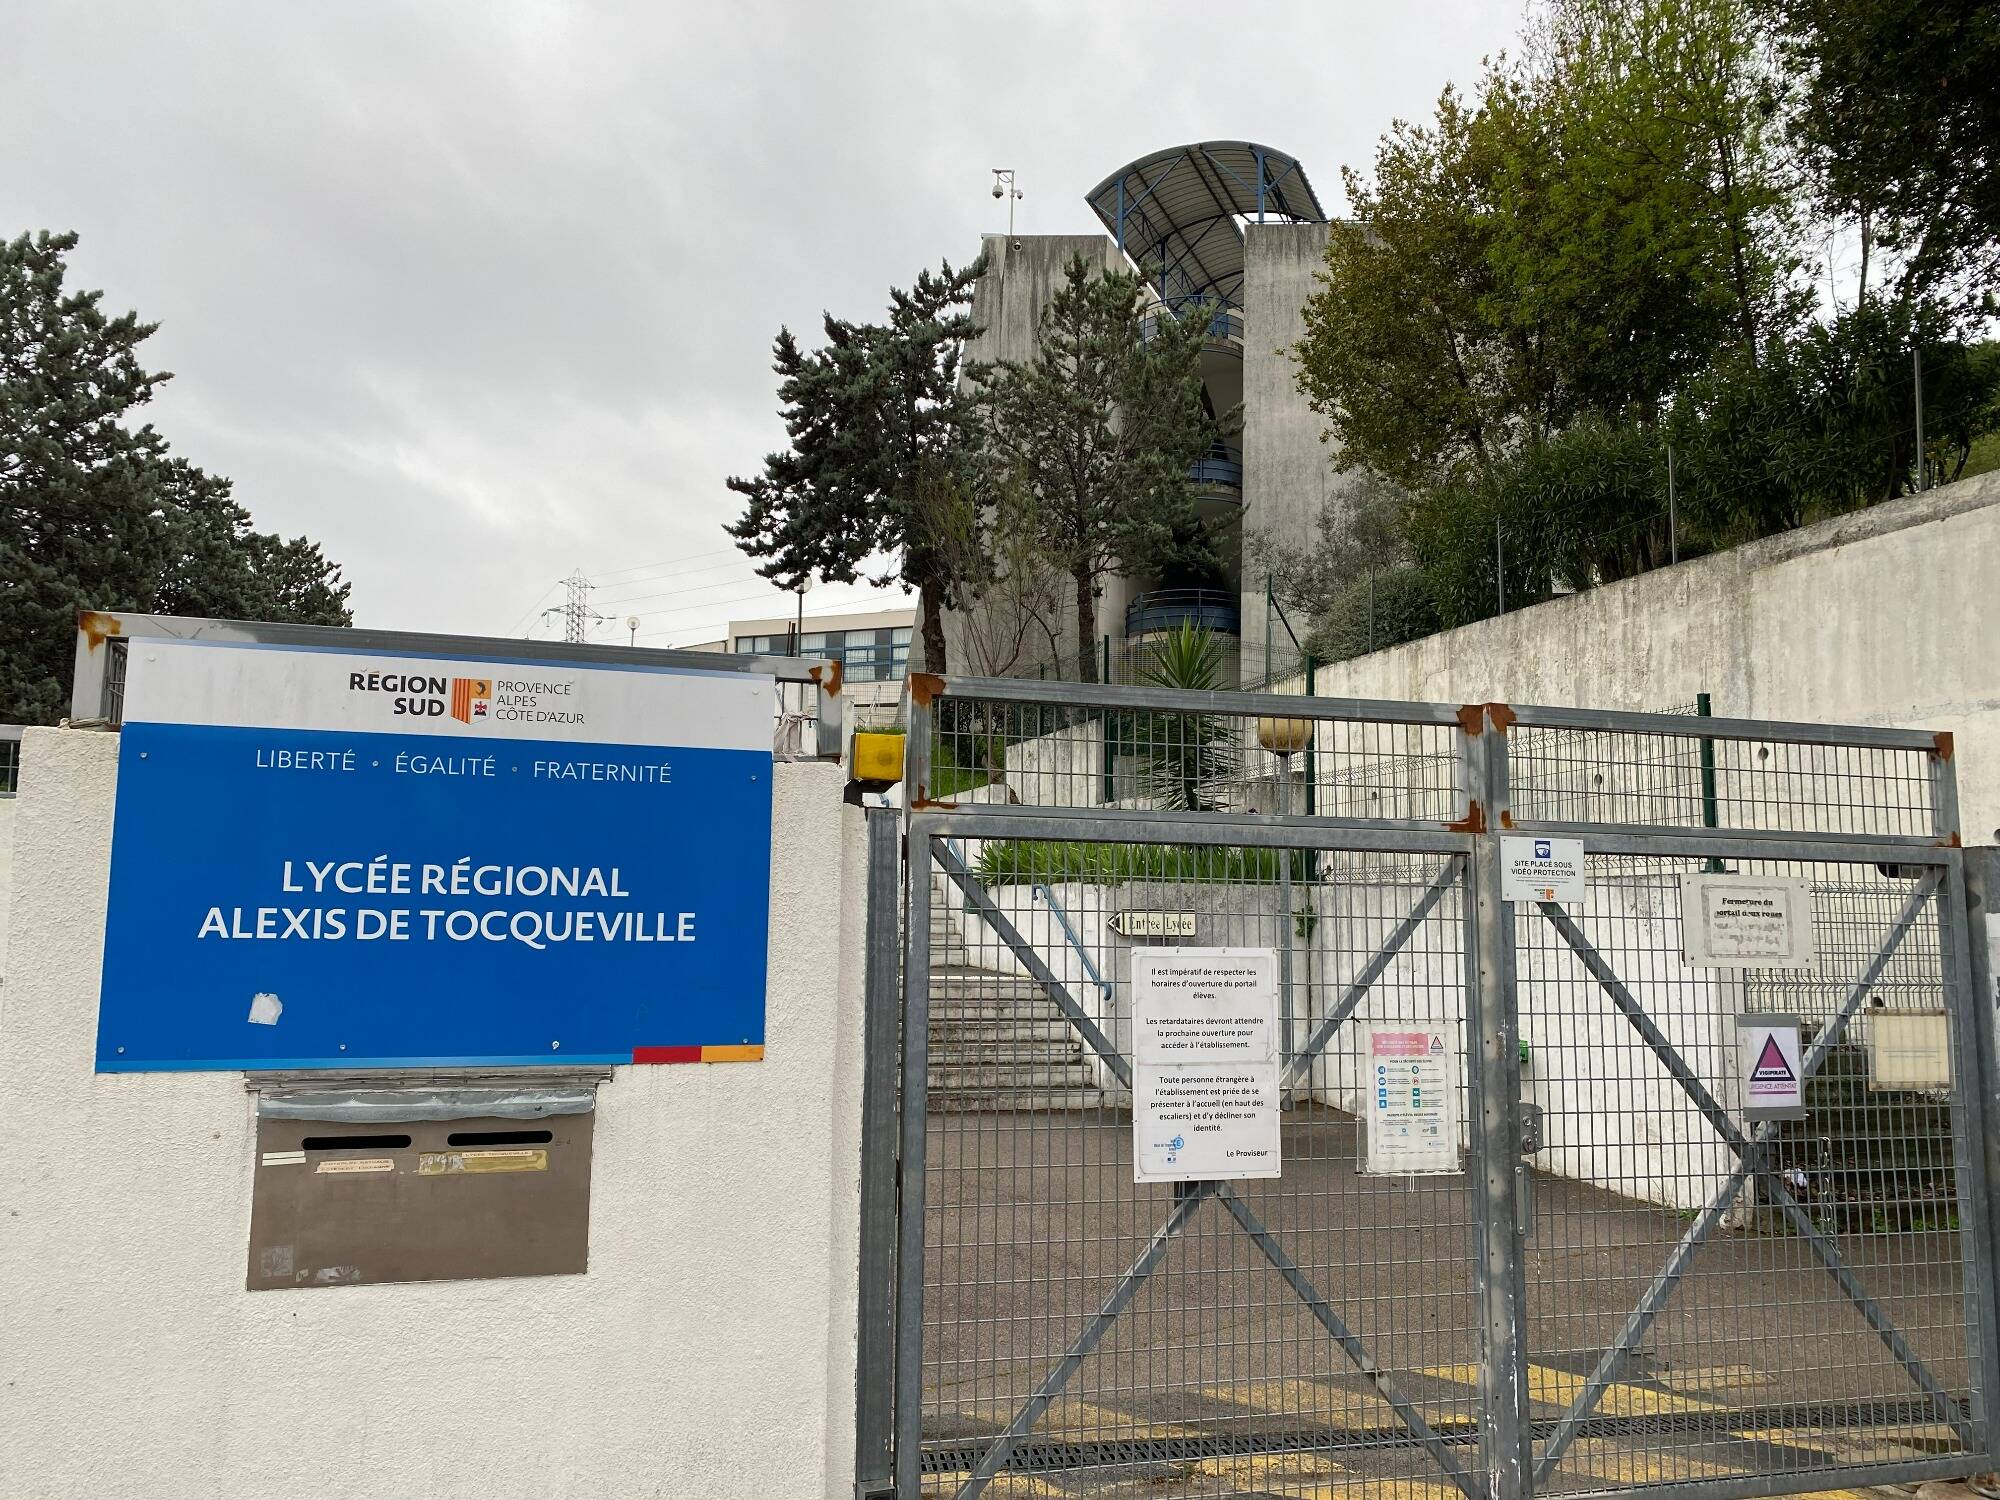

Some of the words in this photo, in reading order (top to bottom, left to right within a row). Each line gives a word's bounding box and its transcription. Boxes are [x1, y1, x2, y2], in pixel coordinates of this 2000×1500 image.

[350, 672, 446, 694] RÉGION
[497, 681, 571, 696] PROVENCE
[496, 695, 538, 708] ALPES
[394, 698, 444, 716] SUD
[496, 706, 533, 721] CÔTE
[536, 711, 585, 724] D'AZUR
[257, 749, 355, 770] LIBERTÉ
[396, 752, 495, 776] ÉGALITÉ
[535, 761, 671, 783] FRATERNITÉ
[283, 855, 410, 893] LYCÉE
[422, 857, 629, 896] RÉGIONAL
[1511, 867, 1532, 875] VIDÉO
[198, 908, 346, 939] ALEXIS
[357, 910, 409, 939] DE
[425, 910, 695, 949] TOCQUEVILLE
[1128, 917, 1161, 930] Entrée
[1151, 968, 1156, 976] Il
[1170, 968, 1201, 977] impératif
[1152, 980, 1180, 988] horaires
[1182, 980, 1222, 988] d'ouverture
[1235, 980, 1256, 989] portail
[1235, 1017, 1263, 1025] attendre
[1166, 1030, 1199, 1039] prochaine
[1196, 1041, 1249, 1049] l'établissement.
[1216, 1076, 1248, 1085] étrangère
[1223, 1088, 1239, 1097] priée
[1151, 1101, 1184, 1110] présenter
[1193, 1100, 1220, 1108] l'accueil
[1222, 1100, 1233, 1109] (en
[1160, 1113, 1191, 1121] escaliers)
[1203, 1112, 1213, 1121] d'y
[1215, 1112, 1241, 1120] décliner
